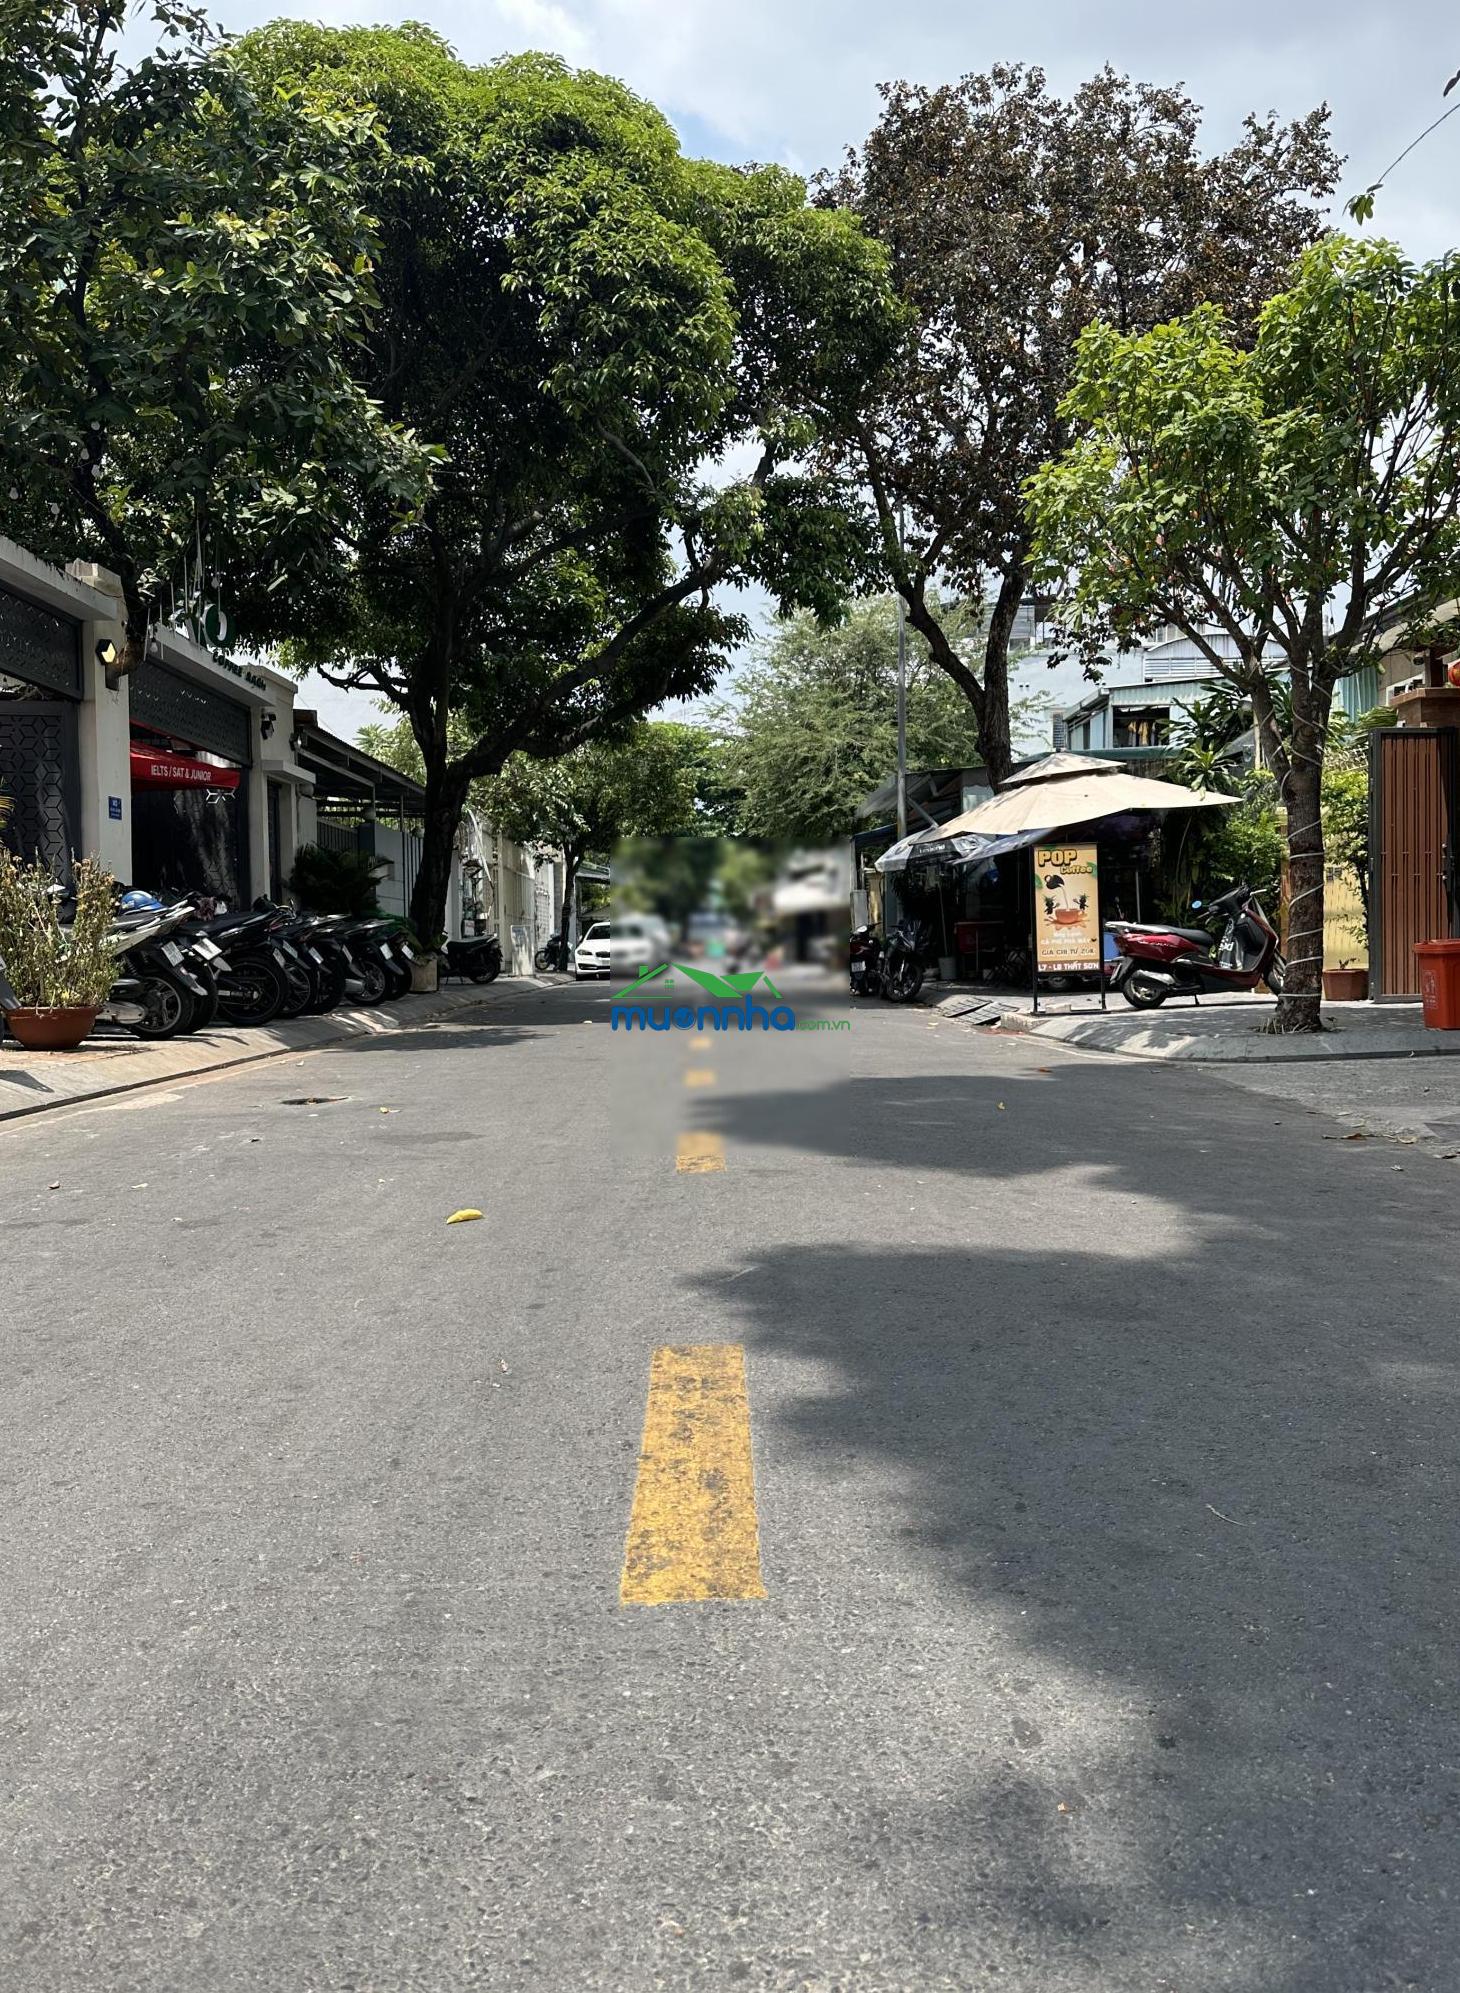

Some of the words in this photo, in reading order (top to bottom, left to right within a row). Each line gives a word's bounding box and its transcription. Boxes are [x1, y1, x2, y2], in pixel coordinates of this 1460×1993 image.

[151, 765, 169, 777] IELTS
[173, 767, 185, 778] SAT
[185, 769, 190, 779] &
[191, 769, 212, 781] JUNIOR
[1038, 849, 1078, 867] POP
[1060, 865, 1094, 875] Coffee
